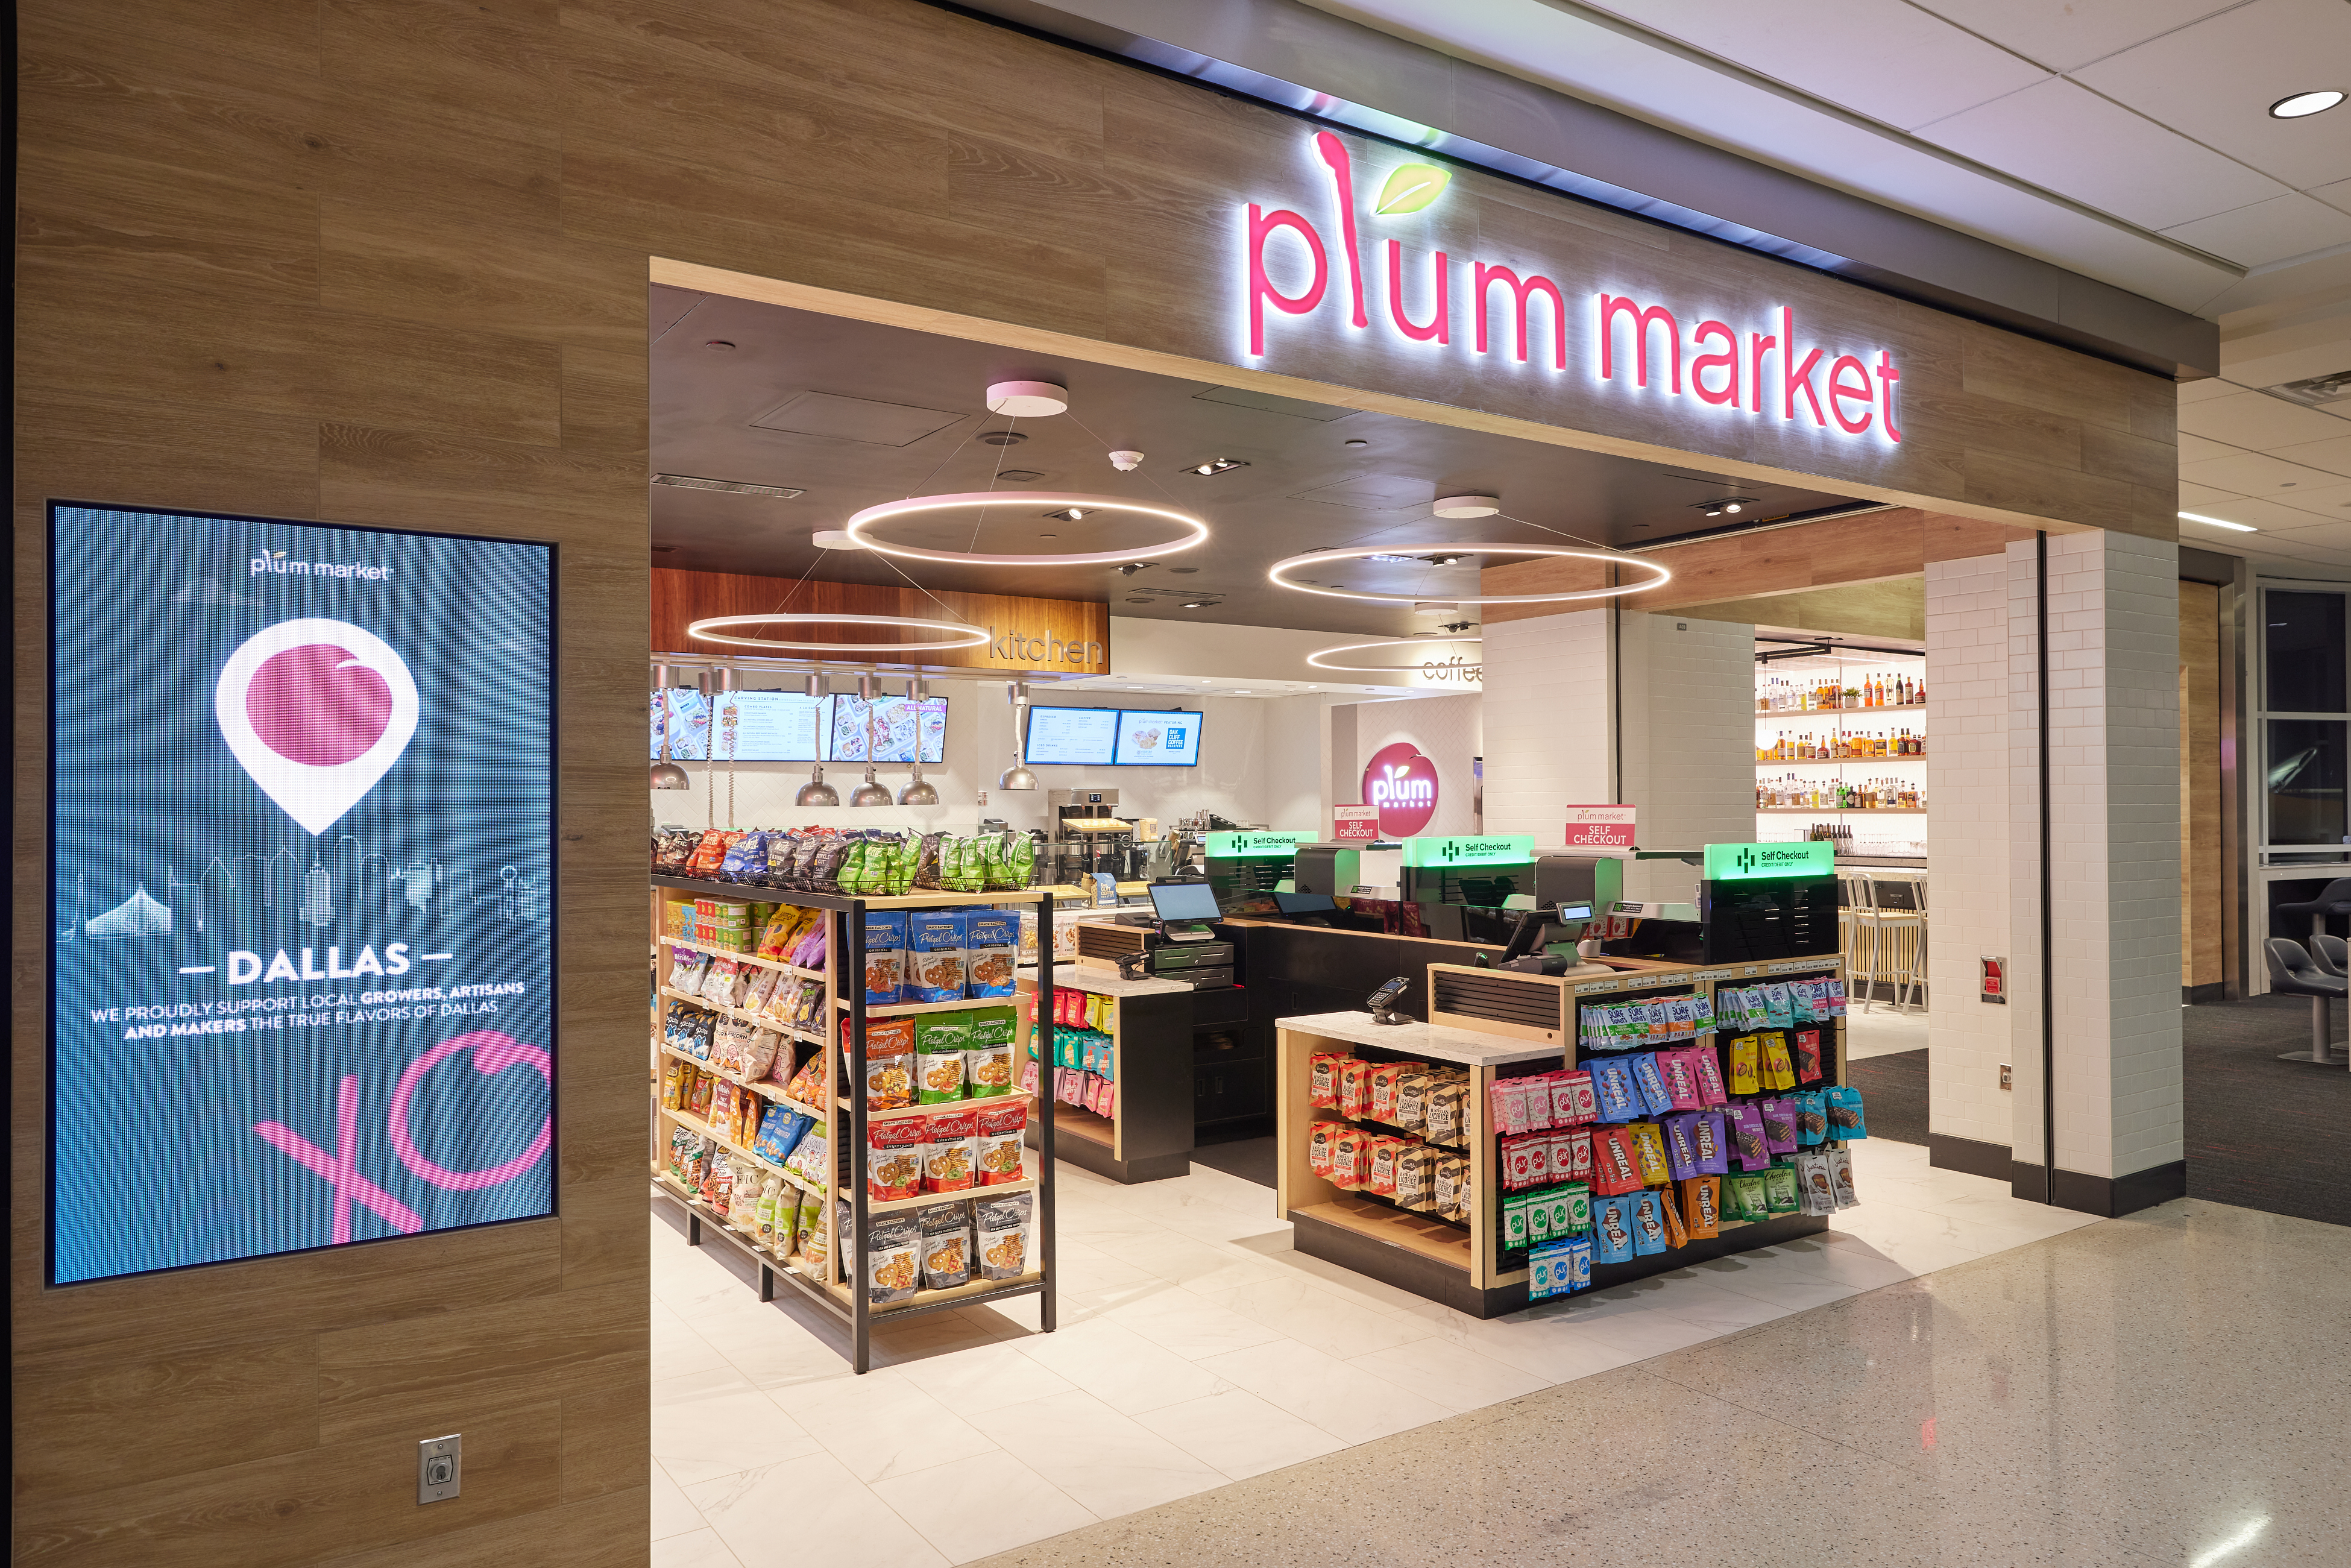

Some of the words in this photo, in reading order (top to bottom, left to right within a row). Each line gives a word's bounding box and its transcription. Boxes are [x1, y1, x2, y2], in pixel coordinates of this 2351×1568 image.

[1242, 130, 1566, 373] plum
[1593, 305, 1901, 444] market
[251, 549, 309, 576] plum
[314, 561, 389, 581] market
[990, 626, 1103, 664] kitchen
[1373, 764, 1432, 802] plum
[1341, 808, 1353, 819] plum
[1577, 810, 1596, 822] plum
[1598, 812, 1624, 820] market
[1339, 828, 1373, 838] CHECKOUT
[1588, 825, 1611, 834] SELF
[1465, 843, 1478, 852] Self
[1480, 842, 1511, 851] Checkout
[1573, 834, 1626, 845] CHECKOUT
[1761, 851, 1775, 860] Self
[1777, 851, 1809, 860] Checkout
[884, 932, 901, 943] Crisps
[920, 933, 942, 946] Pretzel
[943, 931, 963, 943] Crisps
[227, 943, 410, 985] DALLAS
[91, 1009, 121, 1022] WE
[124, 1002, 213, 1021] PROUDLY
[216, 997, 298, 1015] SUPPORT
[301, 993, 357, 1009] LOCAL
[360, 987, 448, 1005] GROWERS,
[450, 980, 525, 999] ARTISANS
[124, 1022, 167, 1040] AND
[170, 1018, 247, 1037] MAKERS
[250, 1015, 283, 1031] THE
[288, 1013, 332, 1028] TRUE
[335, 1006, 411, 1026] FLAVORS
[414, 1004, 438, 1020] OF
[441, 1000, 498, 1018] DALLAS
[866, 1038, 889, 1053] Pretzel
[889, 1037, 909, 1048] Crisps
[921, 1034, 945, 1046] Pretzel
[946, 1033, 965, 1045] Crisps
[1641, 1062, 1666, 1103] UNREAL
[1671, 1059, 1689, 1100] UNREAL
[1701, 1056, 1720, 1094] UNREAL
[1607, 1068, 1627, 1110] UNREAL
[926, 1122, 952, 1137] Pretzel
[952, 1120, 974, 1132] Crisps
[979, 1117, 1003, 1129] Pretzel
[1002, 1115, 1024, 1127] Crisps
[873, 1129, 900, 1142] Pretzel
[900, 1127, 922, 1138] Crisps
[1698, 1121, 1713, 1162] UNREAL
[1640, 1132, 1657, 1173] UNREAL
[1673, 1125, 1692, 1167] UNREAL
[1516, 1159, 1527, 1171] pür
[1533, 1154, 1544, 1168] pür
[1608, 1138, 1630, 1180] UNREAL
[1835, 1158, 1849, 1167] Justin's
[1374, 1166, 1391, 1175] LICORICE
[1806, 1163, 1827, 1172] Justin's
[737, 1174, 759, 1184] EPIC
[1399, 1176, 1416, 1185] LICORICE
[1765, 1170, 1792, 1181] Chocolove
[1435, 1185, 1452, 1194] LICORICE
[1739, 1180, 1760, 1188] Chocolove
[1700, 1185, 1712, 1227] UNREAL
[922, 1214, 946, 1229] Pretzel
[946, 1211, 965, 1223] Crisps
[982, 1210, 1006, 1225] Pretzel
[1006, 1207, 1027, 1219] Crisps
[1534, 1212, 1546, 1224] pür
[1555, 1208, 1565, 1221] pür
[1641, 1198, 1656, 1242] UNREAL
[869, 1227, 898, 1243] Pretzel
[898, 1225, 917, 1238] Crisps
[1606, 1206, 1620, 1251] UNREAL
[1555, 1265, 1567, 1277] pür
